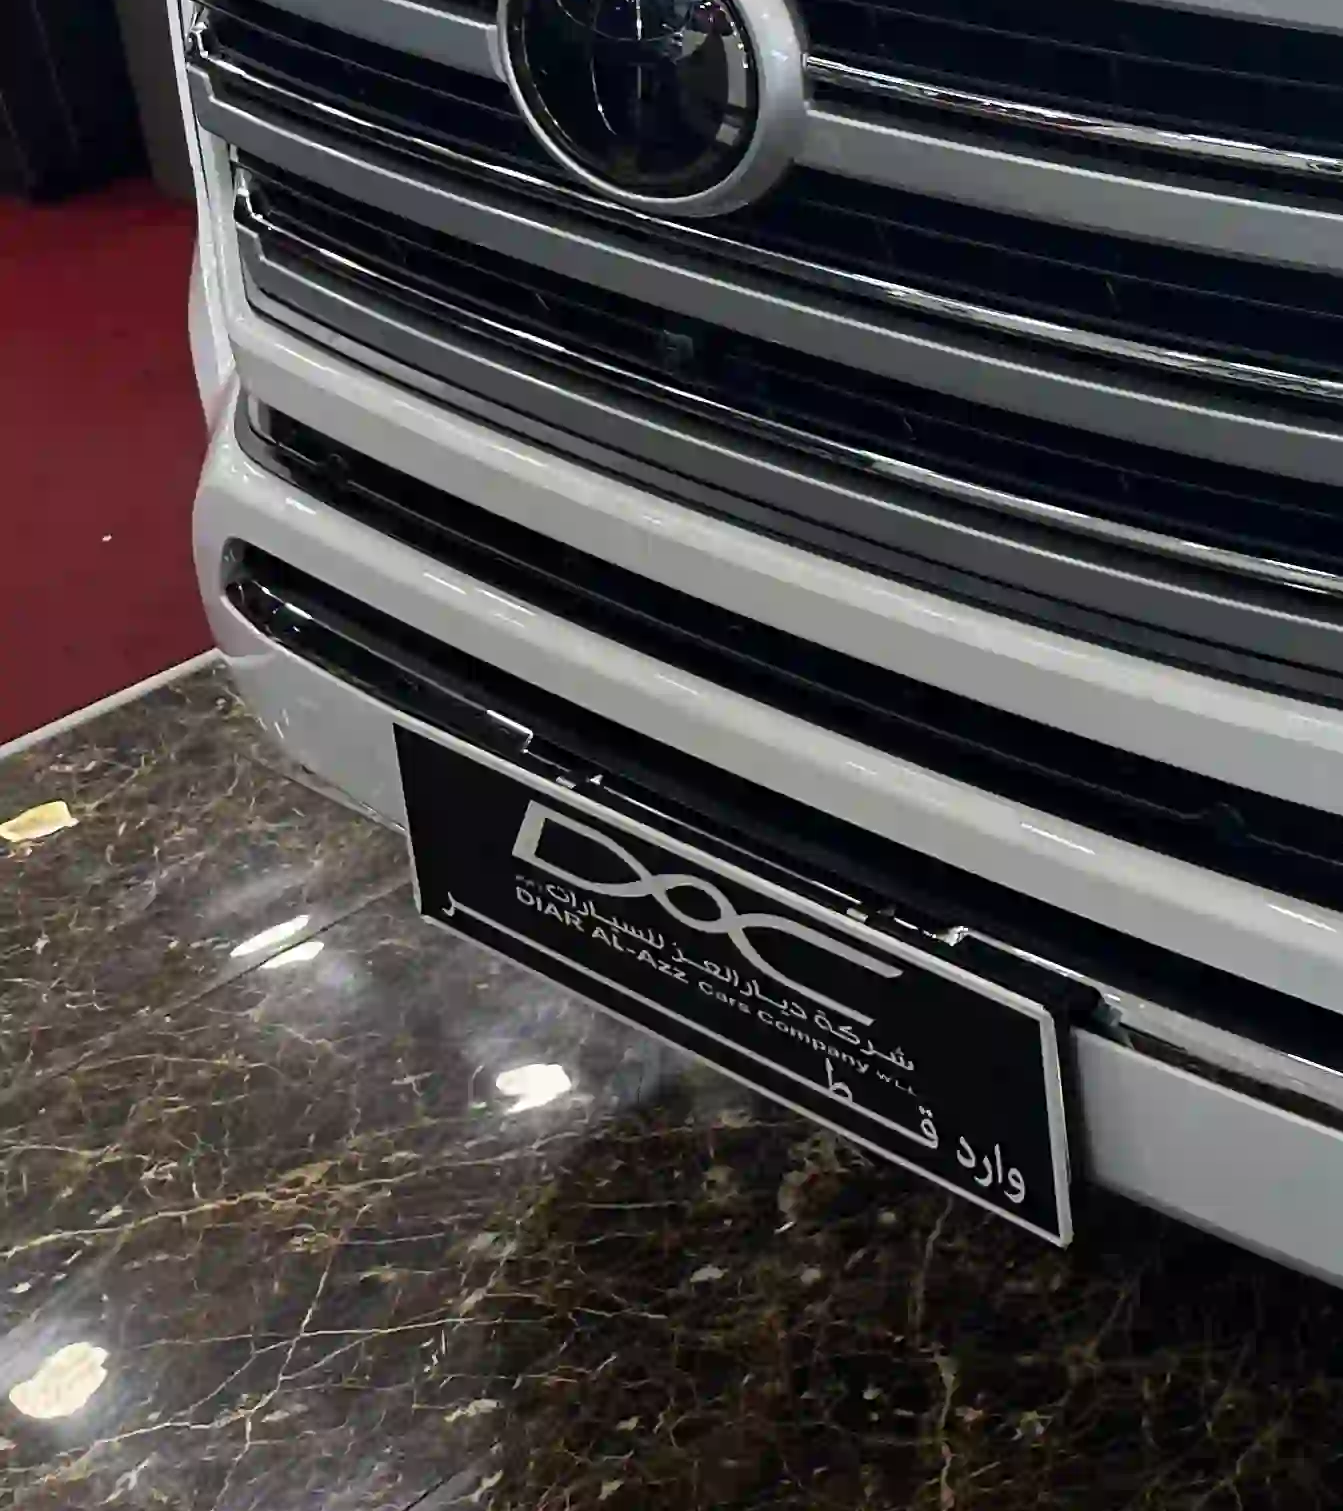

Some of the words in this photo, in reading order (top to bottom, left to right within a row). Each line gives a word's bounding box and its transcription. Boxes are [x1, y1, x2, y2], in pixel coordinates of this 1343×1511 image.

[515, 885, 585, 933] DIAR
[591, 926, 690, 985] AL-AZZ
[698, 980, 752, 1015] Cars
[756, 1009, 870, 1075] Company
[739, 979, 808, 1021] ديار
[814, 1009, 914, 1072] شركة
[956, 1135, 1026, 1204] وارد
